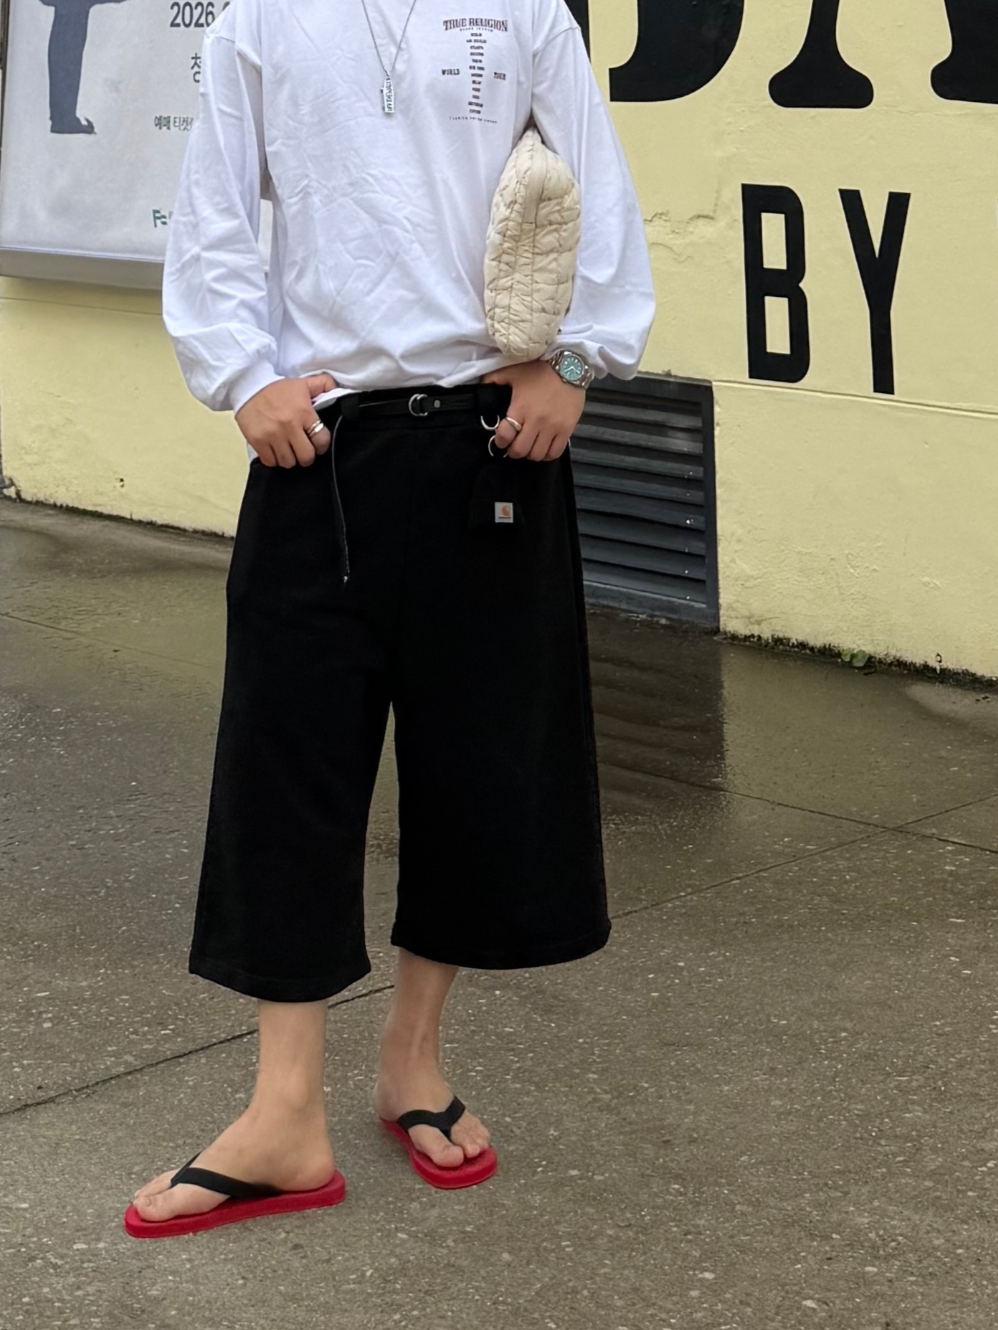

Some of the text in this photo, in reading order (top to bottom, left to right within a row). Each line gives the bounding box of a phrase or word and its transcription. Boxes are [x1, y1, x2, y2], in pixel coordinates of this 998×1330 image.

[443, 17, 508, 33] TRUE RELIGION
[741, 183, 911, 396] BY
